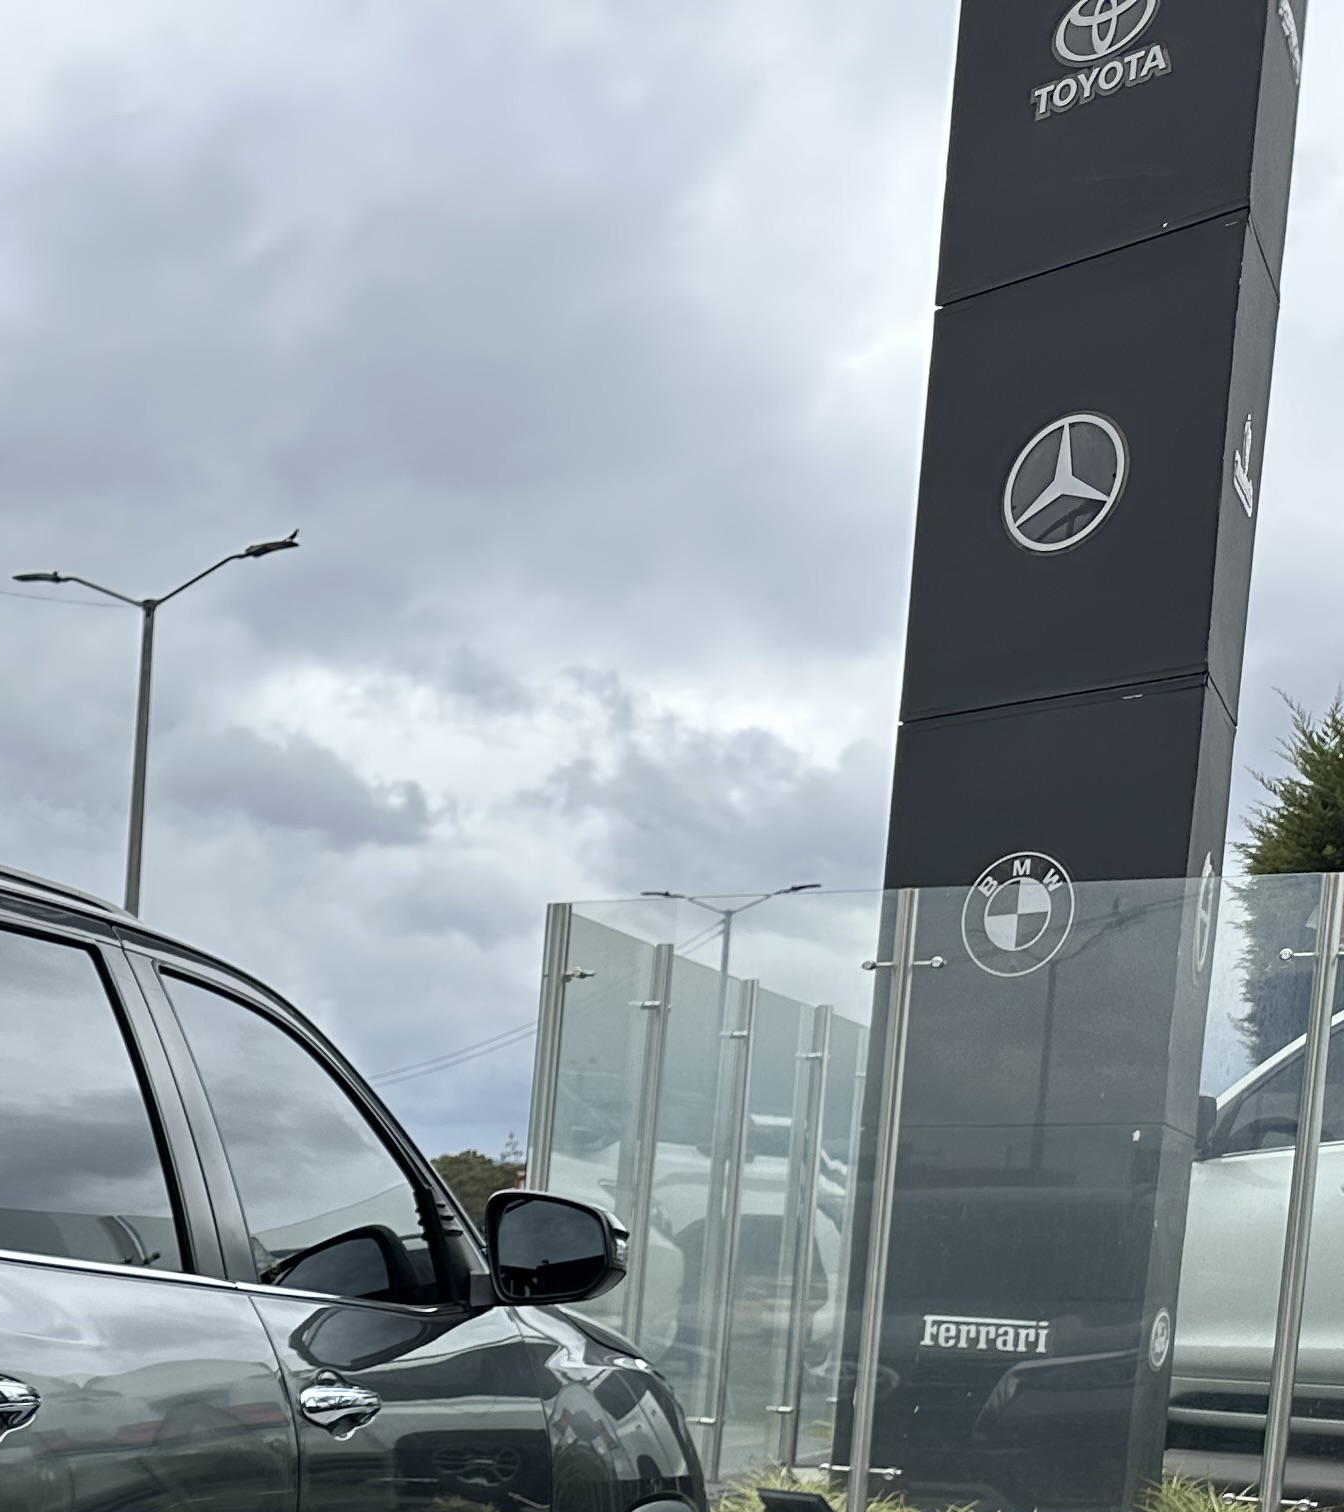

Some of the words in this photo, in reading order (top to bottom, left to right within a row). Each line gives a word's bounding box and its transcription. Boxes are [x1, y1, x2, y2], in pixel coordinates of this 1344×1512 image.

[1034, 44, 1167, 114] TOYOTA
[978, 858, 1064, 897] BMW
[920, 1315, 1050, 1353] Ferrari
